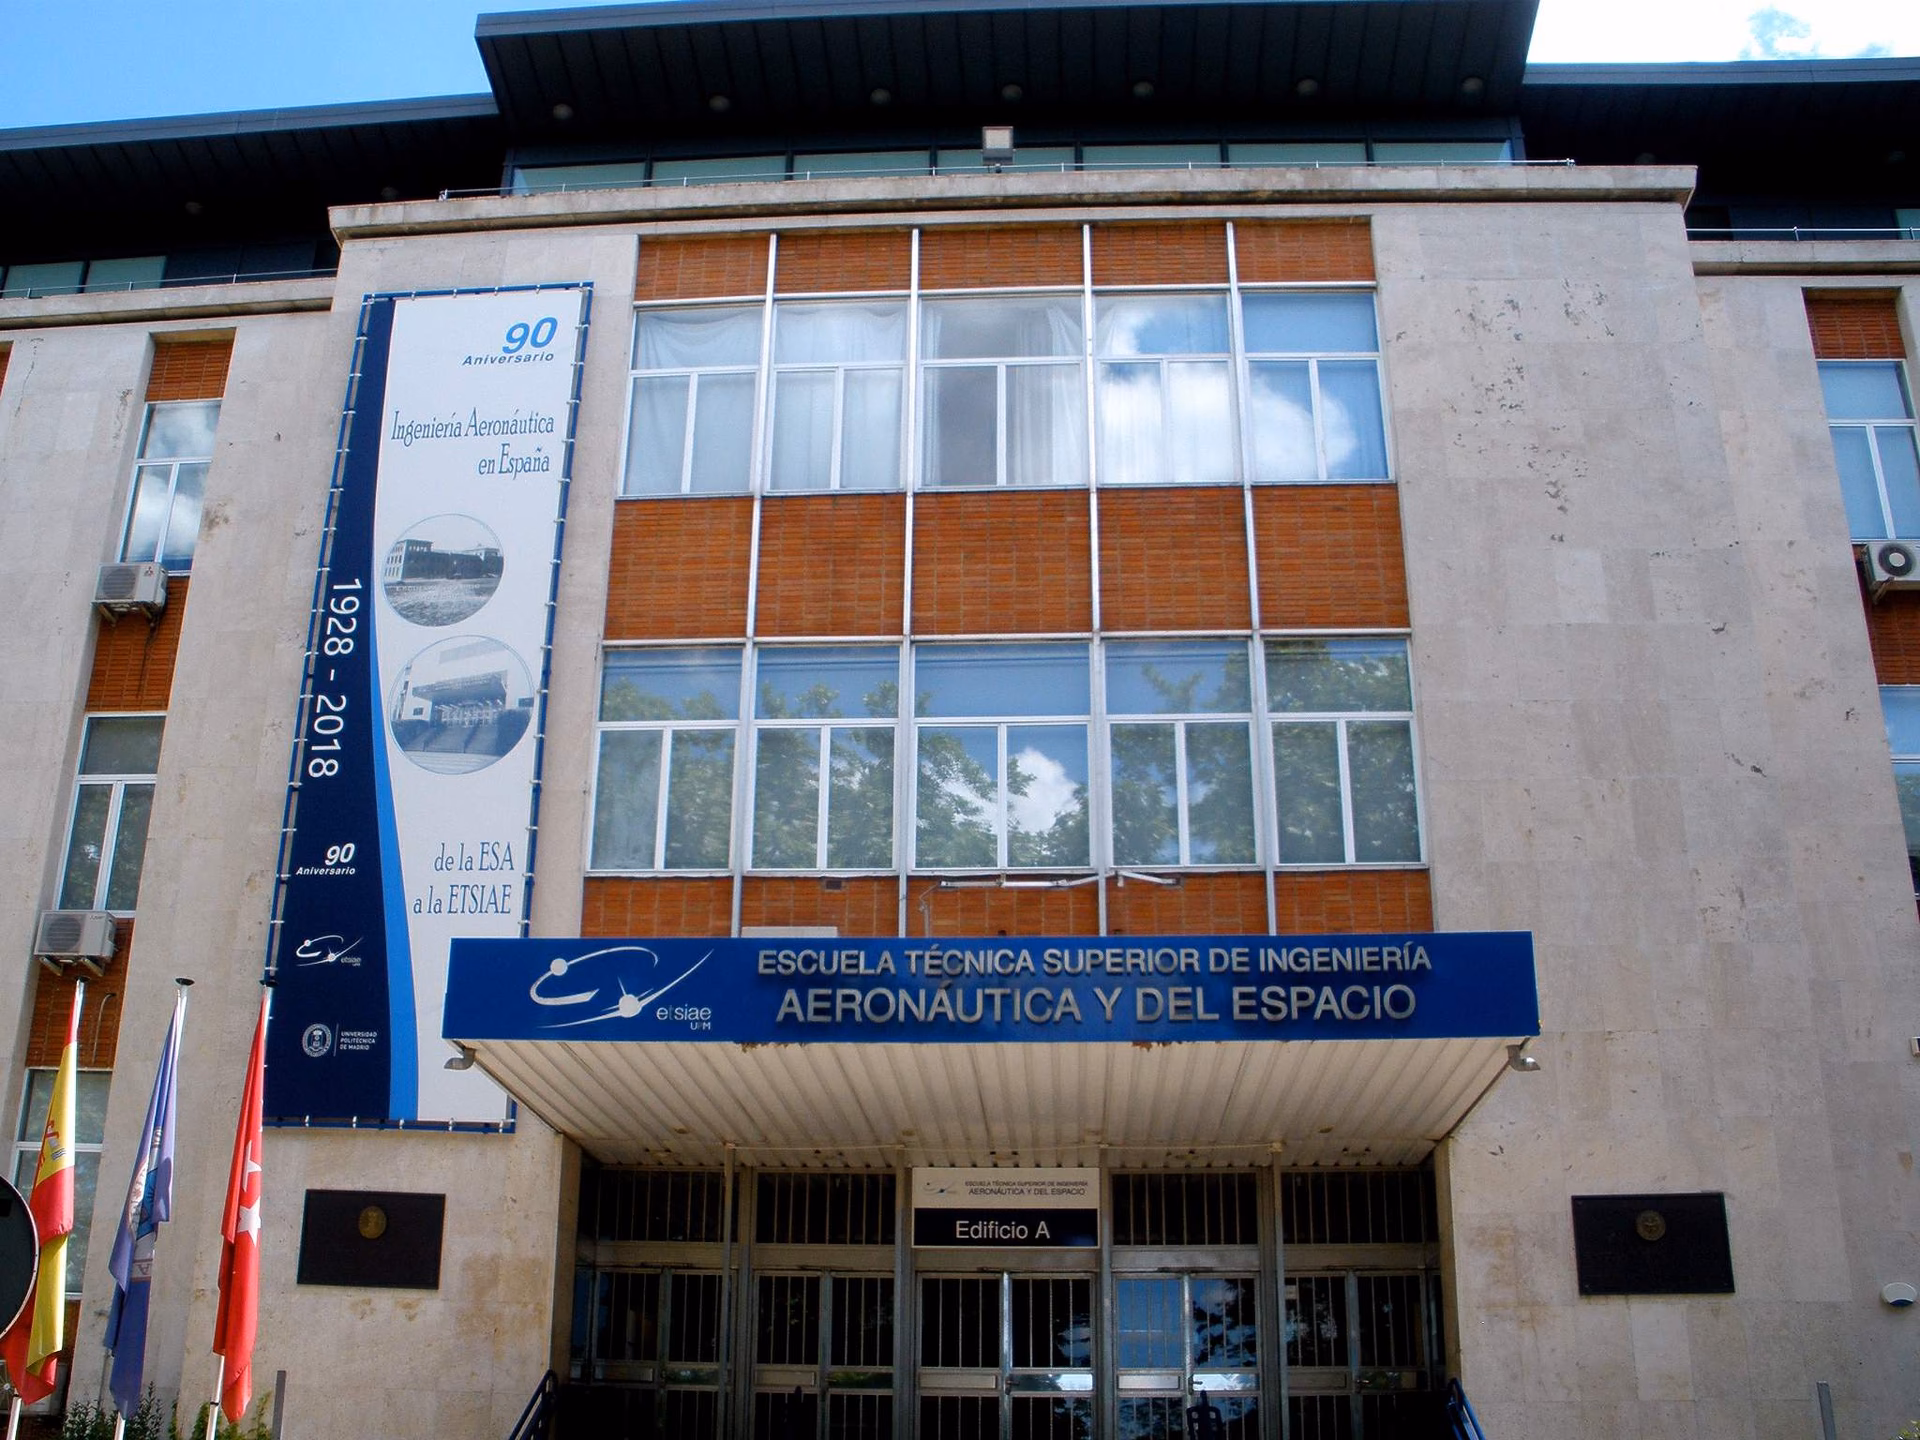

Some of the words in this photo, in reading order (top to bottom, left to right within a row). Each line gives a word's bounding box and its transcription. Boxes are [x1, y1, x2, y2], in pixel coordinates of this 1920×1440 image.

[502, 317, 558, 354] 90
[462, 352, 554, 366] Aniversario
[391, 410, 463, 447] Ingeniería
[464, 407, 554, 437] Aeronáutica
[478, 458, 495, 475] en
[498, 443, 550, 480] España
[324, 578, 362, 656] 1928
[308, 695, 346, 778] 2018
[325, 843, 356, 865] 90
[434, 842, 454, 872] de
[458, 842, 474, 872] la
[478, 841, 515, 871] ESA
[296, 866, 356, 876] Aniversario
[413, 898, 423, 914] a
[427, 885, 443, 914] la
[447, 884, 512, 914] ETSIAE
[757, 949, 897, 976] ESCUELA
[904, 943, 1036, 975] TÉCNICA
[1043, 948, 1201, 975] SUPERIOR
[1209, 948, 1250, 973] DE
[1259, 941, 1432, 973] INGENIERÍA
[776, 980, 1083, 1024] AERONÁUTICA
[1094, 987, 1123, 1022] Y
[1136, 987, 1220, 1022] DEL
[1232, 984, 1417, 1022] ESPACIO
[968, 1187, 1025, 1195] AERONÁUTICA
[1050, 1187, 1086, 1195] ESPACIO
[955, 1220, 1028, 1239] Edificio
[1034, 1220, 1050, 1239] A
